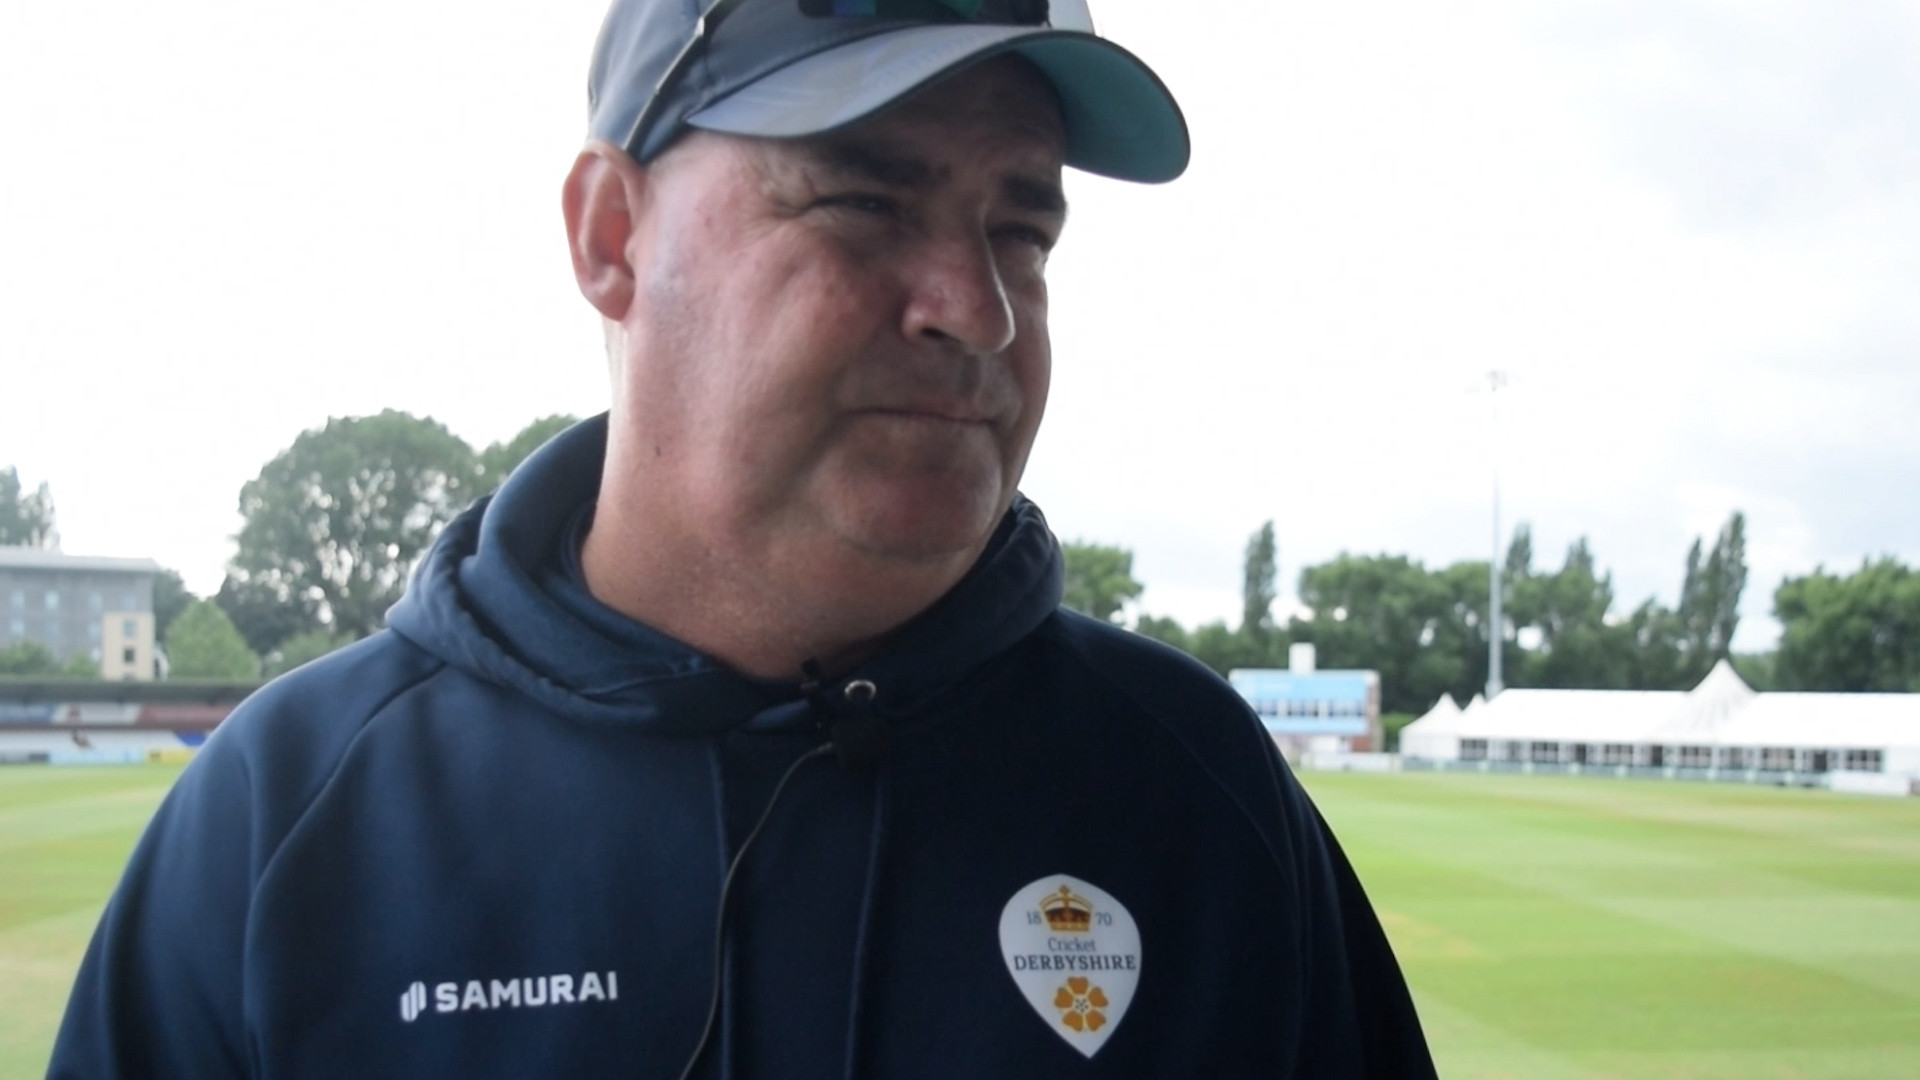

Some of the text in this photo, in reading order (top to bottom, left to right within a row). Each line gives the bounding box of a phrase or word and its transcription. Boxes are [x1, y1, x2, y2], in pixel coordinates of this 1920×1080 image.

[1027, 911, 1112, 926] 18 70
[1047, 937, 1097, 952] Cricket
[1014, 954, 1136, 971] DERBYSHIRE
[435, 970, 618, 1013] SAMURAI
